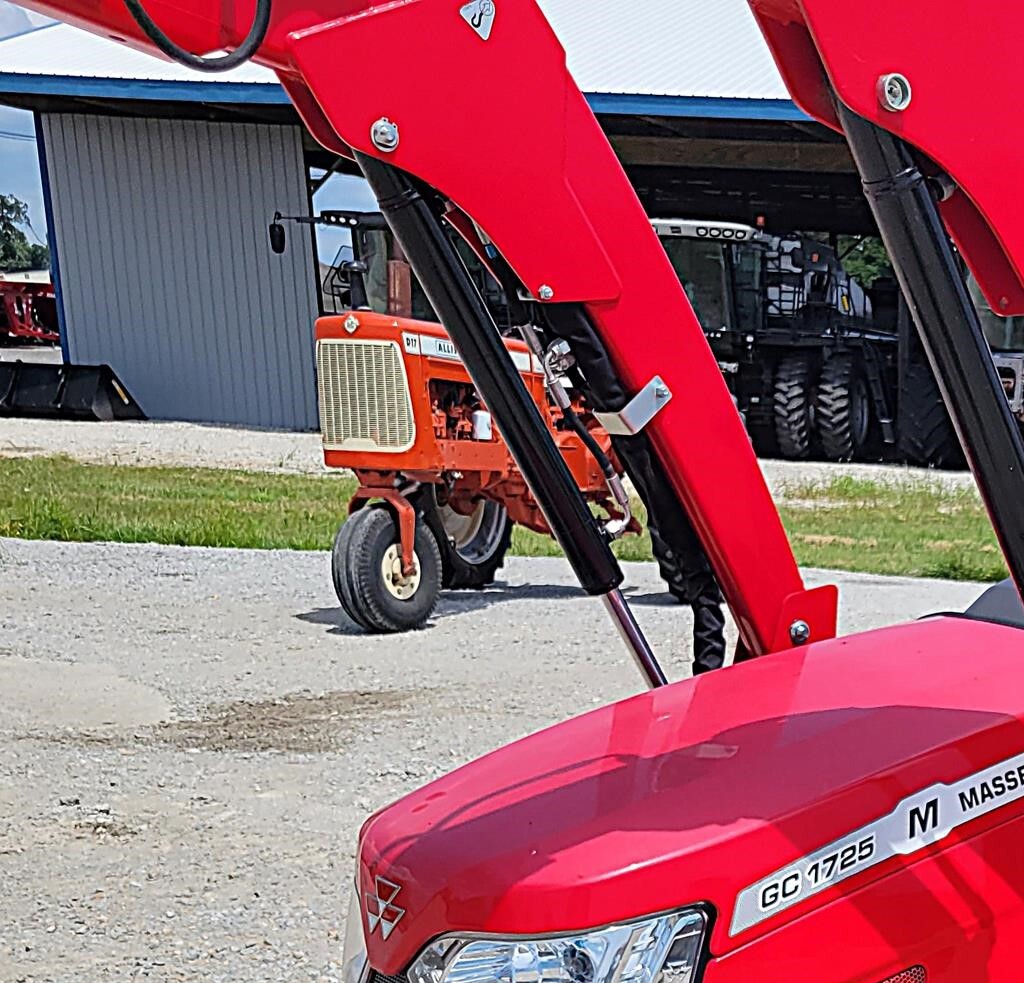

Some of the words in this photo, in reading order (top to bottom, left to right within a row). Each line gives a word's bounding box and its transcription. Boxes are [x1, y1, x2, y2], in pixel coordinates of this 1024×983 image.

[405, 337, 417, 348] D17
[761, 873, 799, 909] GC
[807, 835, 875, 885] 1725
[908, 798, 939, 839] M
